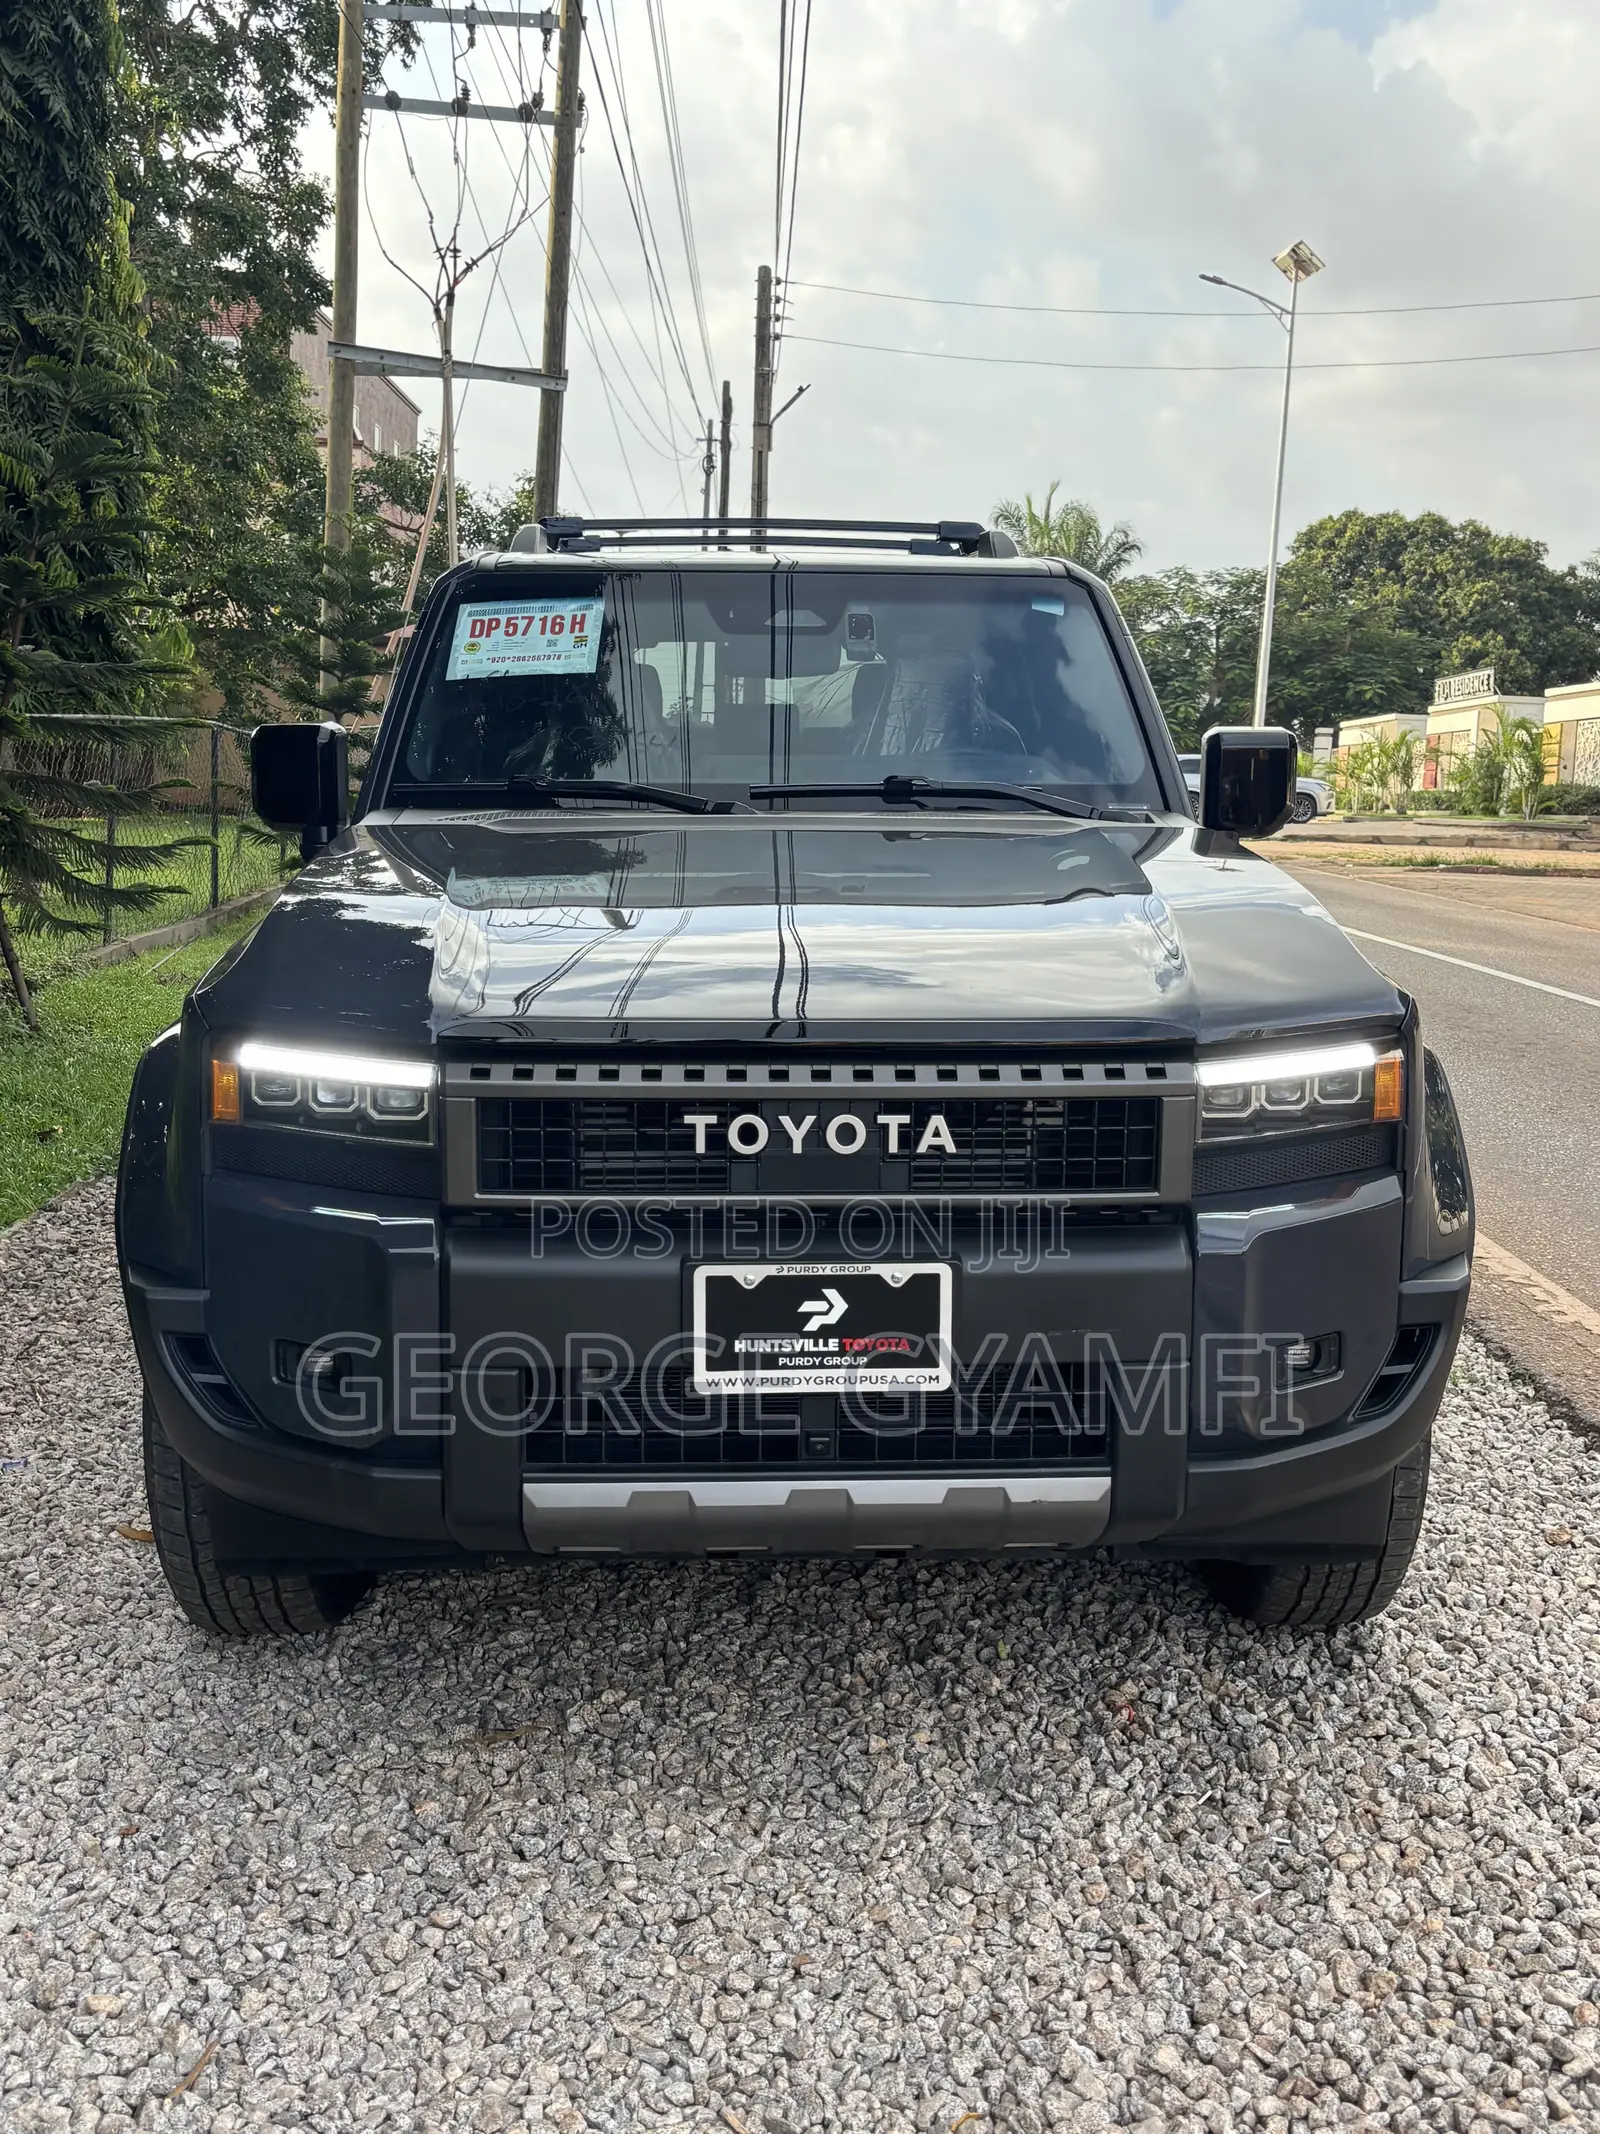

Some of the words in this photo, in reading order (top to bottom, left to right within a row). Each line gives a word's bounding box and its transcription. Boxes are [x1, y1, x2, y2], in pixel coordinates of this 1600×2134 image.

[469, 617, 501, 639] DP
[503, 614, 565, 637] 5716
[569, 612, 587, 634] H
[572, 642, 588, 650] GH
[1451, 673, 1489, 697] RESIDENCE
[683, 1114, 957, 1155] TOYOTA
[786, 1265, 827, 1274] PURDY
[830, 1265, 872, 1273] GROUP
[734, 1339, 839, 1353] HUNTSVILLE
[842, 1338, 911, 1352] TOYOTA
[778, 1356, 821, 1367] PURDY
[823, 1356, 868, 1366] GROUP
[705, 1374, 941, 1388] WWW.PURDYGROUPUSA.COM
